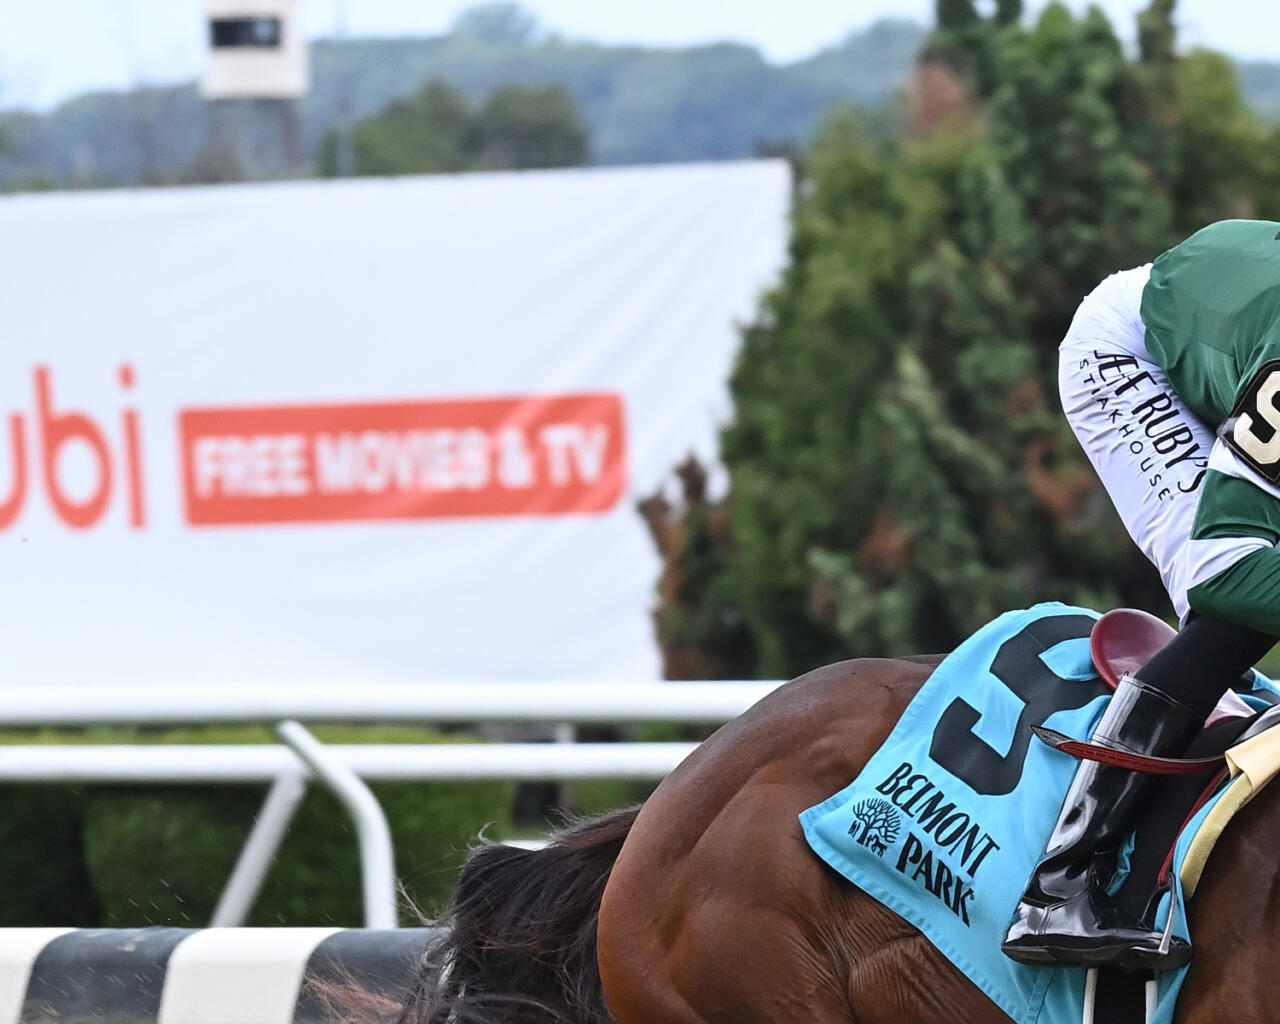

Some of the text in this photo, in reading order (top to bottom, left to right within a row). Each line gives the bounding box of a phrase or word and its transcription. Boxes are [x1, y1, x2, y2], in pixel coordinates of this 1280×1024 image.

[194, 434, 309, 498] FREE
[314, 429, 490, 495] MOVIES
[541, 422, 608, 488] TV
[1079, 359, 1171, 501] STAKHOUSE
[929, 614, 1112, 796] 9
[875, 762, 1001, 879] BELMONT
[895, 831, 975, 928] PARK
